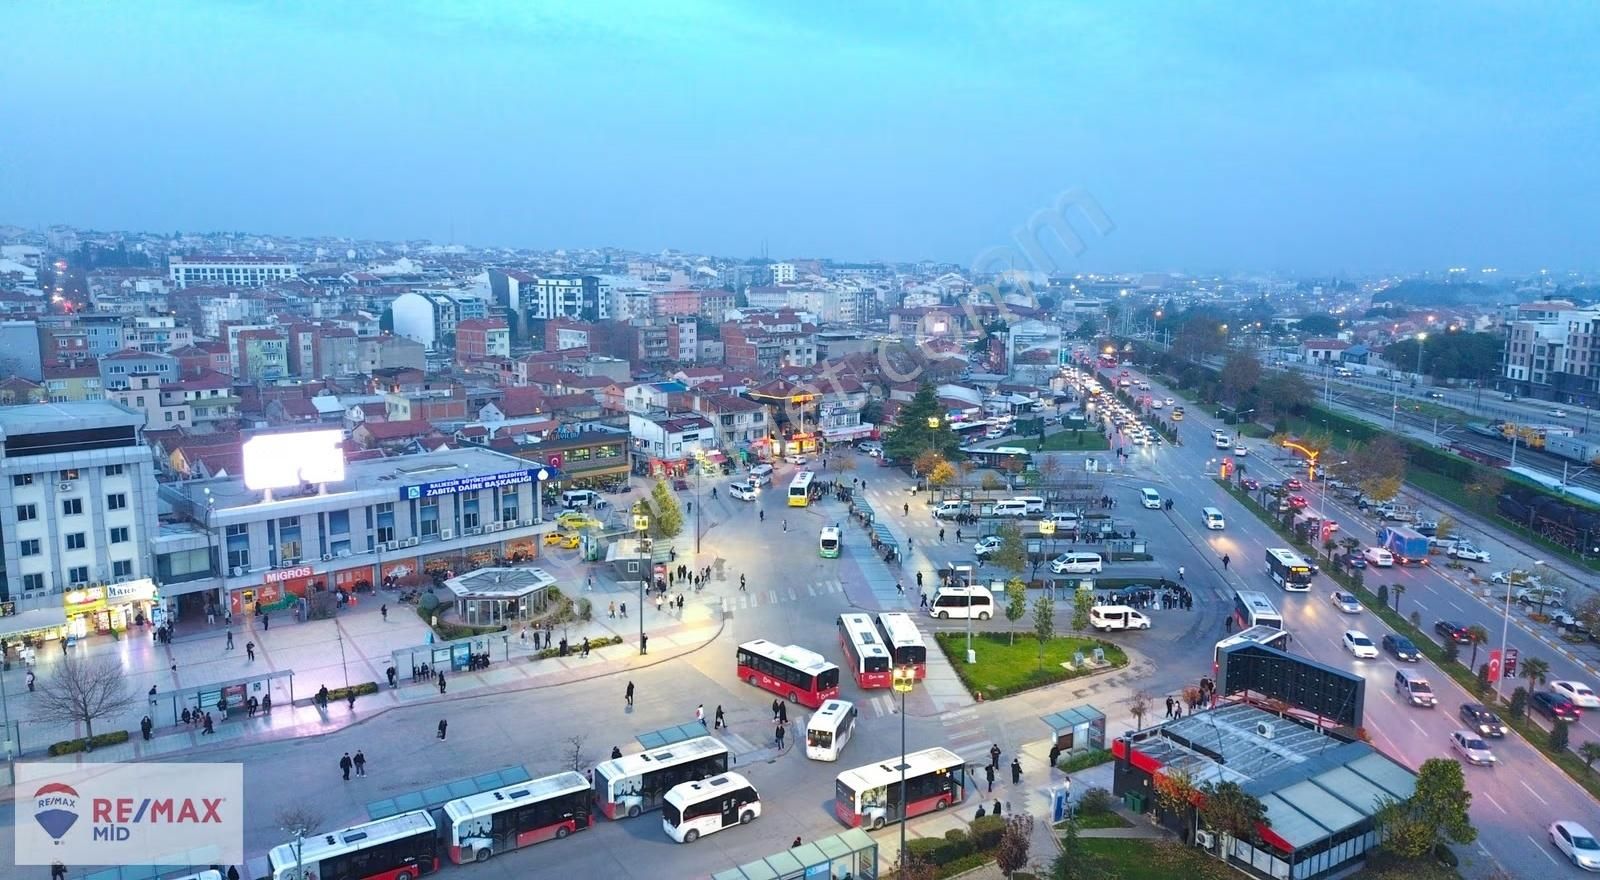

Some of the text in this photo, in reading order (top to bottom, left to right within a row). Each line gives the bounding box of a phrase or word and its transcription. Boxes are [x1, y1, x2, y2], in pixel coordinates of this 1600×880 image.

[426, 475, 532, 497] ZABITA DAİRE BAŞKANLIĞI
